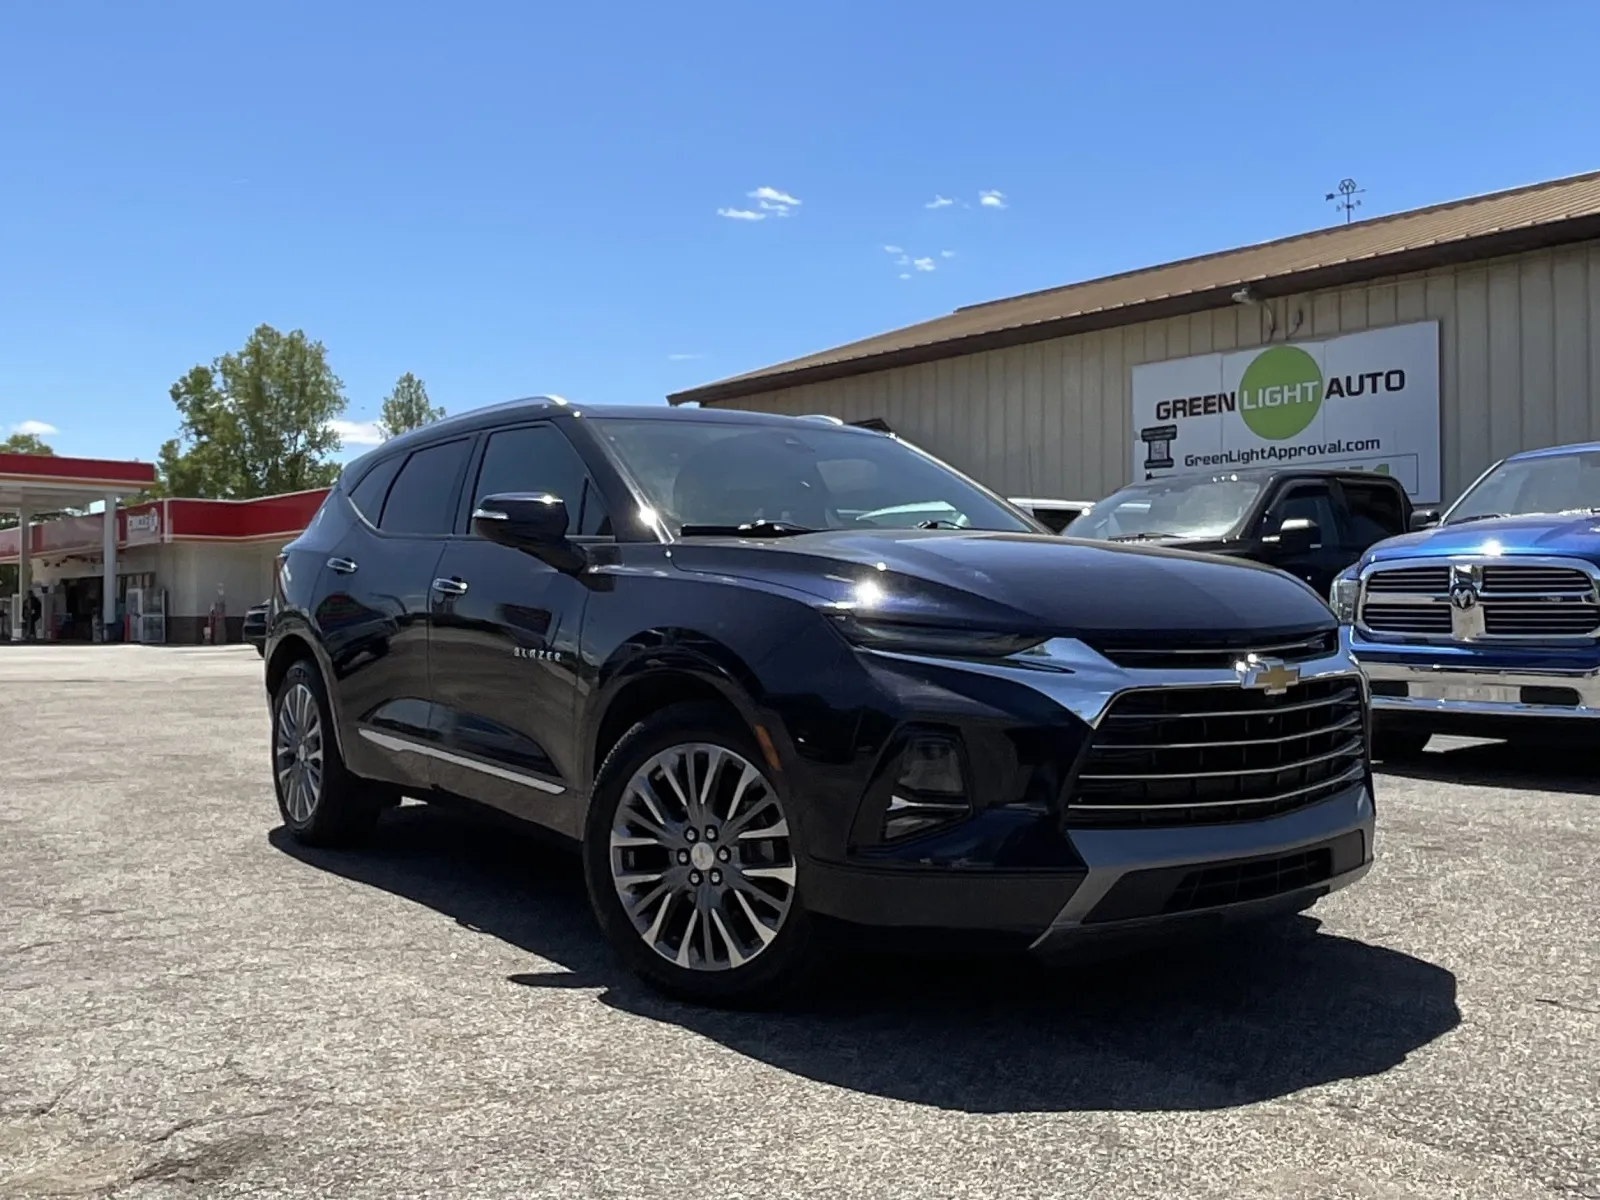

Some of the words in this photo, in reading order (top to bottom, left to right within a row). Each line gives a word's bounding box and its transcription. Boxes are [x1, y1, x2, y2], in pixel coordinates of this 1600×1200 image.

[1156, 391, 1236, 420] GREEN
[1243, 381, 1319, 410] LIGHT
[1325, 369, 1405, 400] AUTO
[1184, 438, 1381, 467] GreenLightApproval.com
[513, 646, 561, 662] BLAZER
